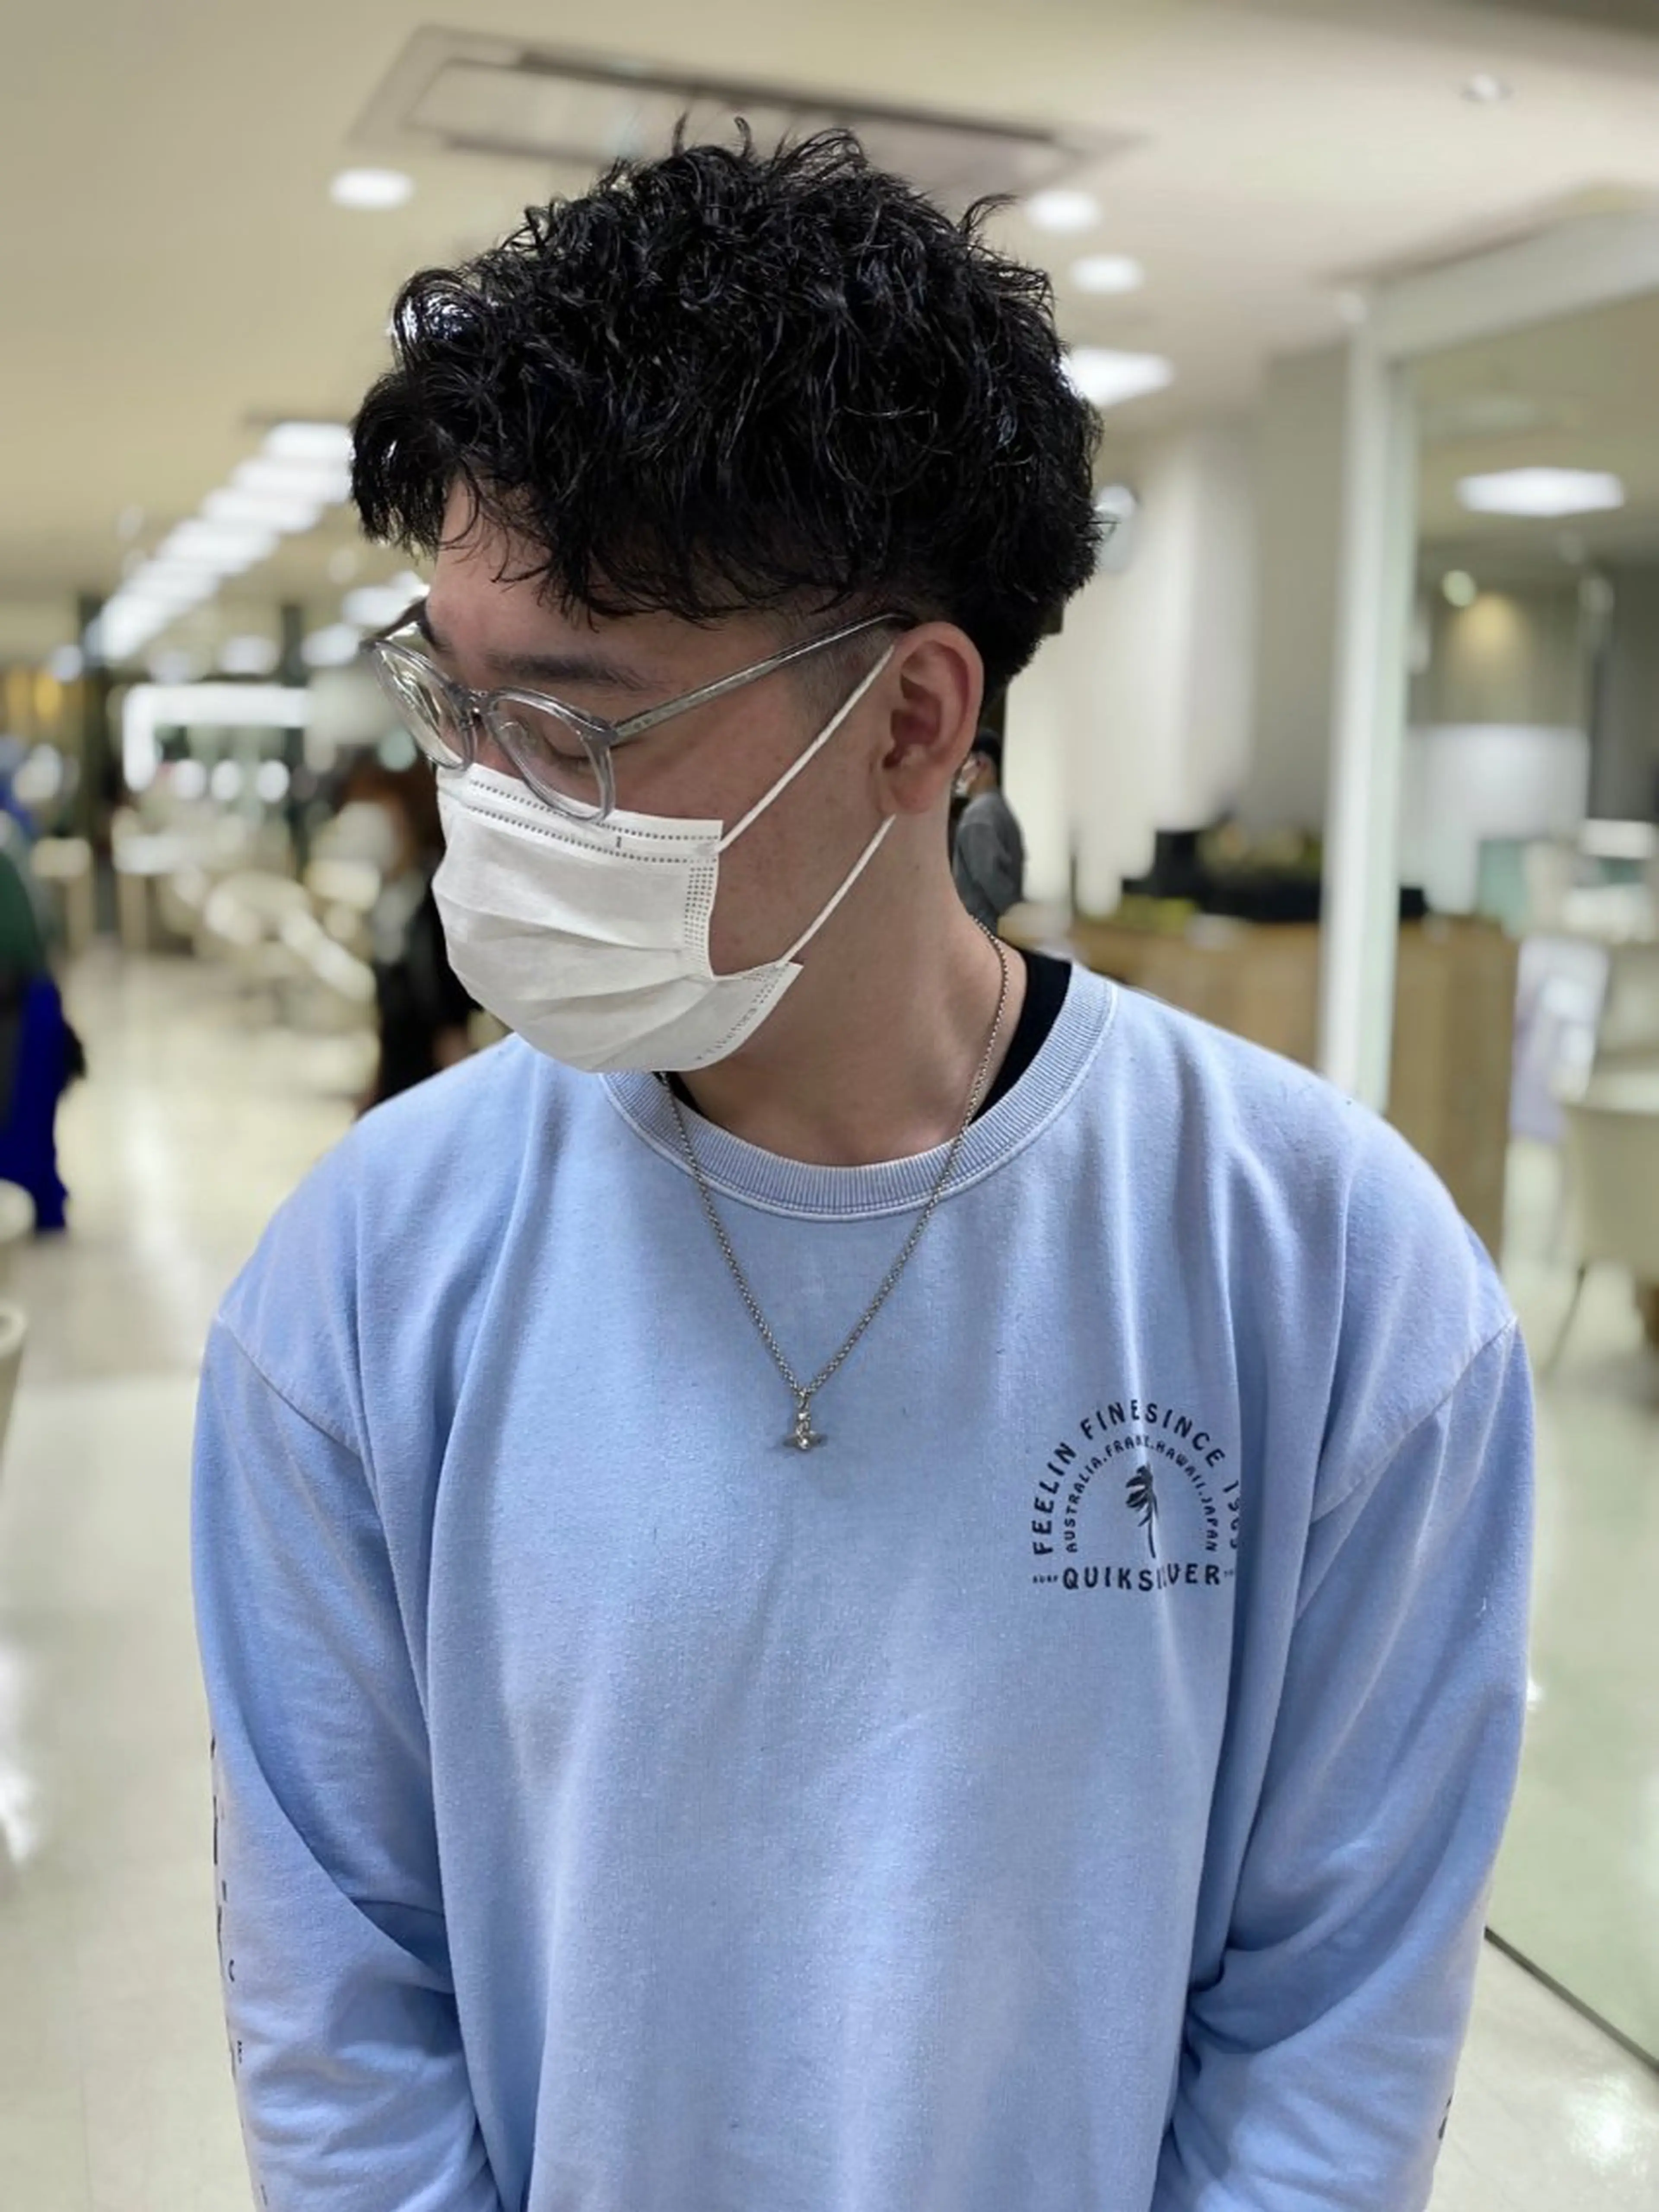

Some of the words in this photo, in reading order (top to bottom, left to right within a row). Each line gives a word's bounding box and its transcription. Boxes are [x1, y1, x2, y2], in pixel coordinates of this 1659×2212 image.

[1032, 1442, 1077, 1556] FEELIN
[1080, 1399, 1140, 1440] FINE
[1145, 1403, 1225, 1468] SINCE
